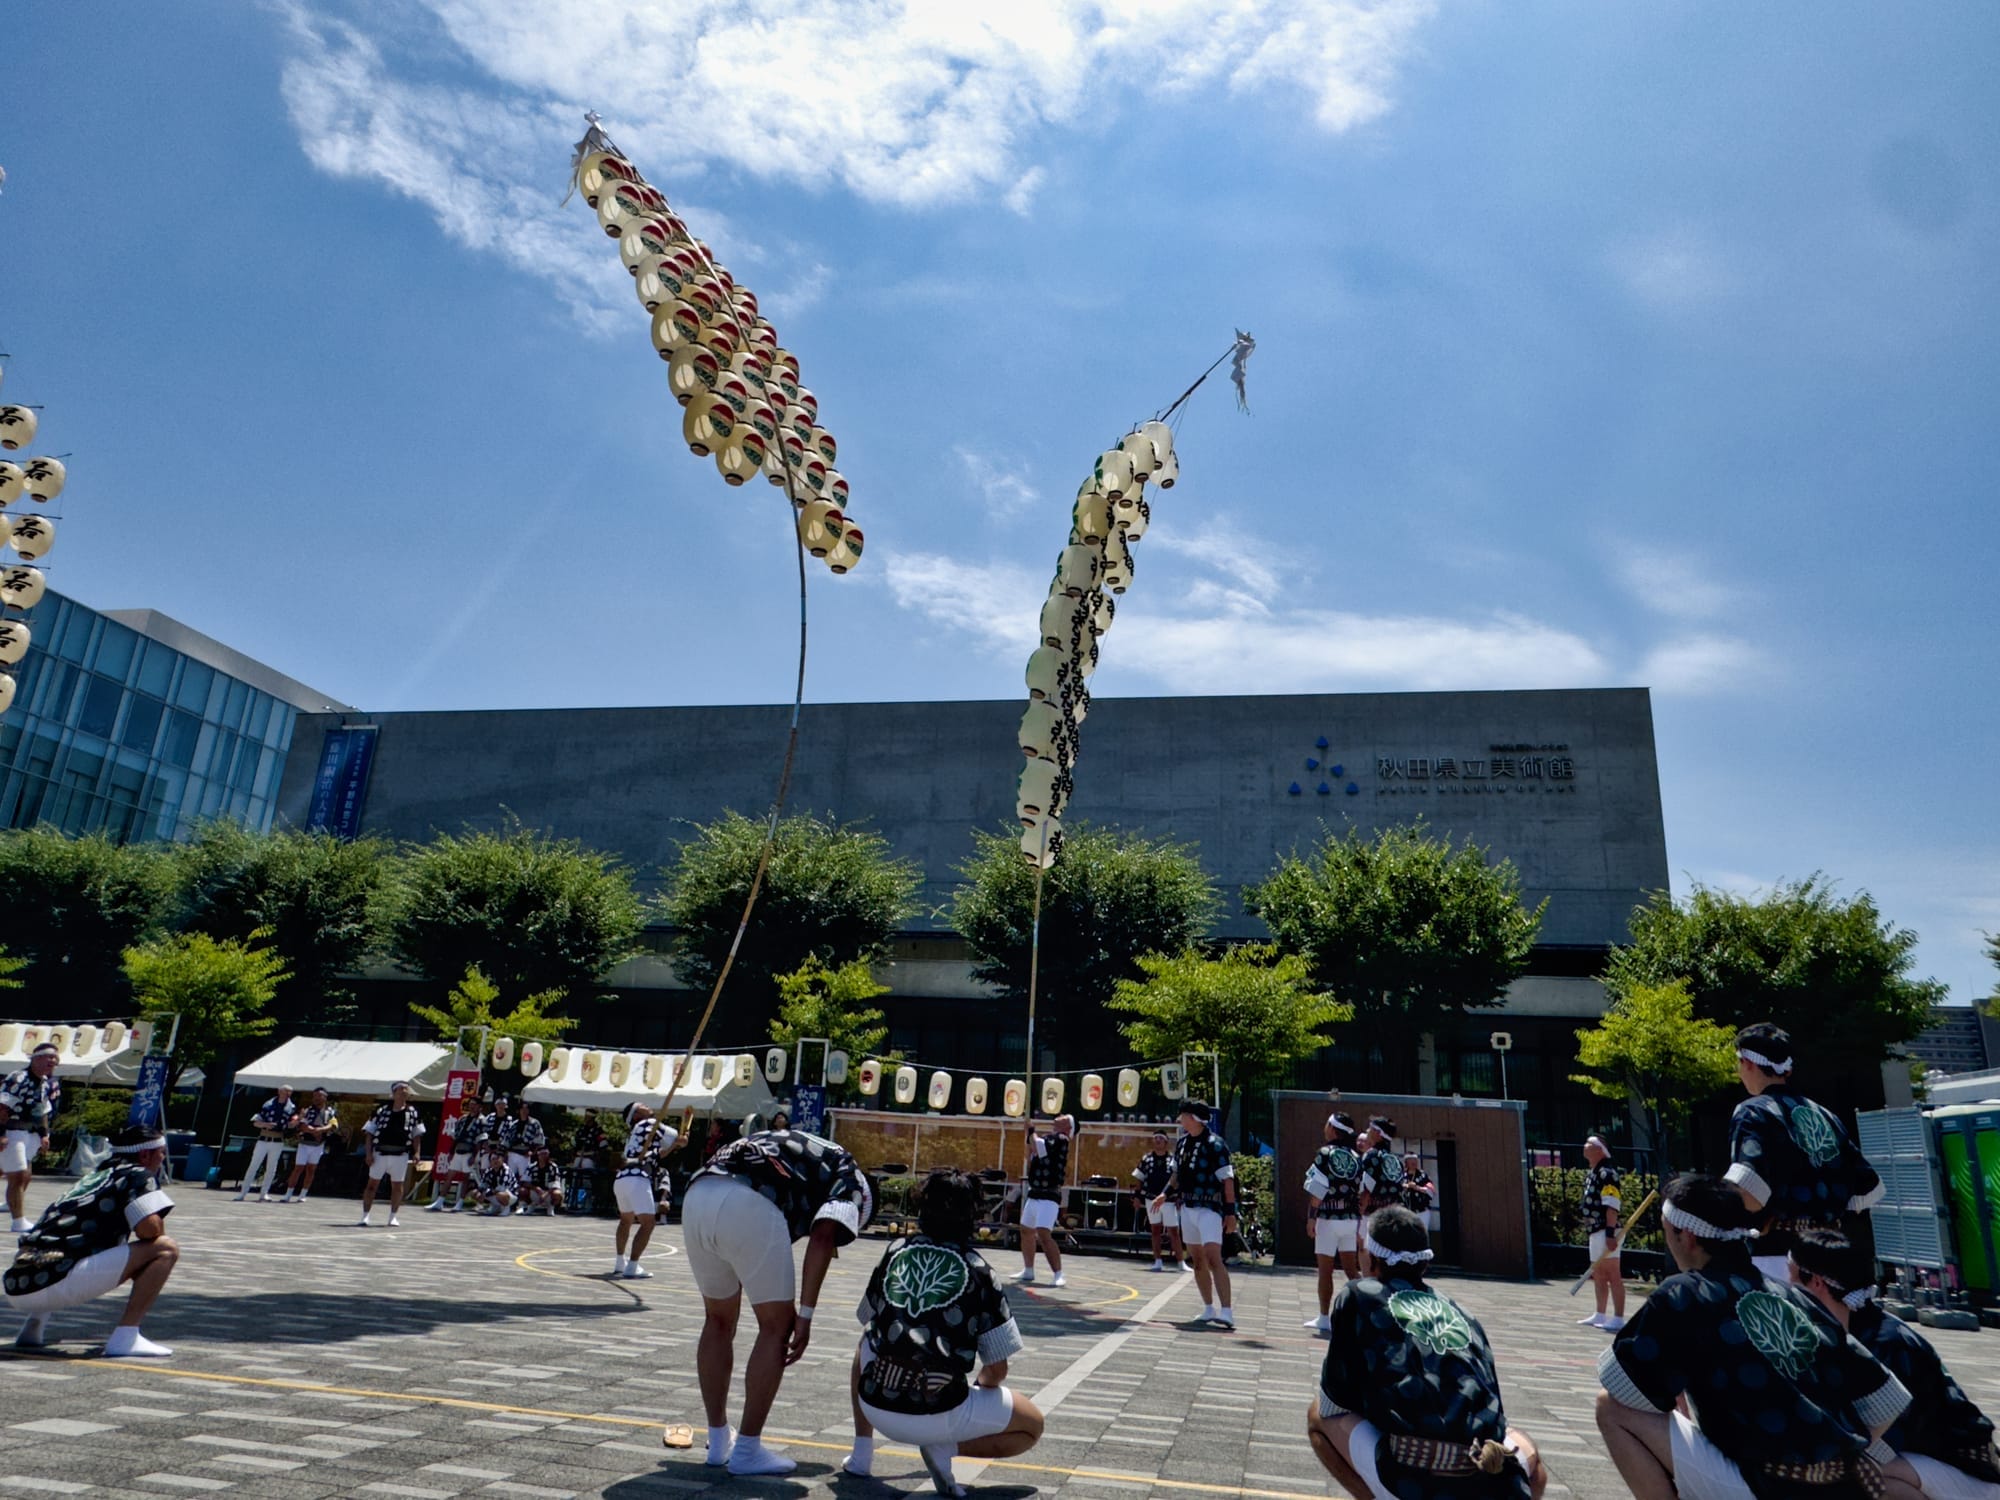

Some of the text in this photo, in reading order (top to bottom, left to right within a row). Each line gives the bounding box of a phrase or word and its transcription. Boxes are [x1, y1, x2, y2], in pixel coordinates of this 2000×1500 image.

[1378, 756, 1575, 780] 秋田県立美術館
[797, 1088, 818, 1100] 秋田
